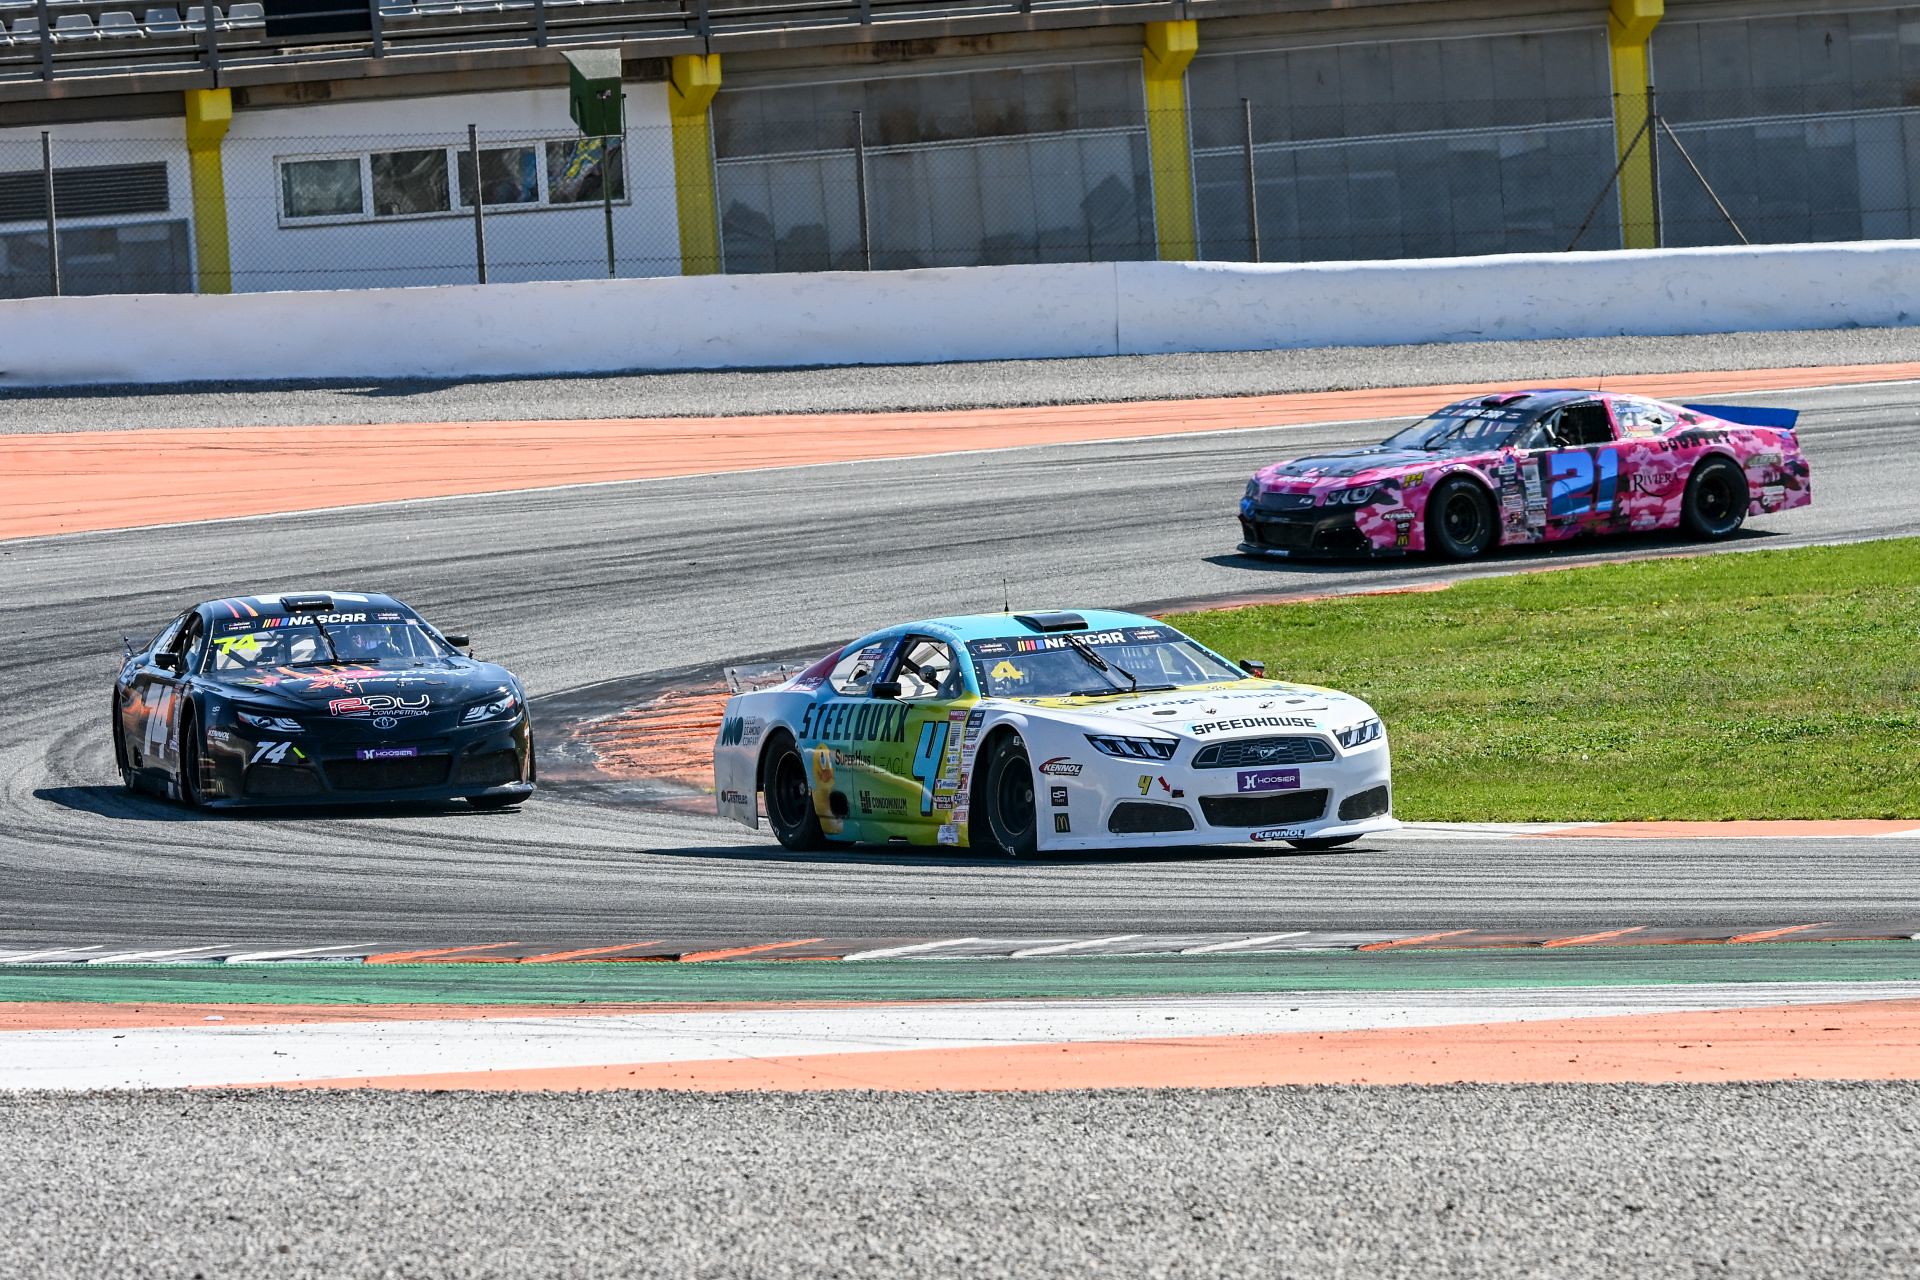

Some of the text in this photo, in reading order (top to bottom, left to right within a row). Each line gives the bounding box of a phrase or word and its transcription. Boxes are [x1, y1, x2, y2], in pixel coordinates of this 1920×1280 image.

[1551, 448, 1618, 516] 21
[288, 613, 367, 626] NASCAR
[214, 634, 258, 655] 74
[990, 660, 1025, 680] 4
[799, 702, 911, 743] STEELDUXX
[1191, 717, 1318, 736] SPEEDHOUSE
[251, 741, 292, 763] 74
[375, 749, 413, 757] HOOSIER
[910, 720, 951, 816] 4
[1043, 763, 1081, 773] KENNOL
[1137, 775, 1153, 795] 4
[1257, 775, 1296, 784] HOOSIER
[1255, 830, 1305, 840] KENNOL
